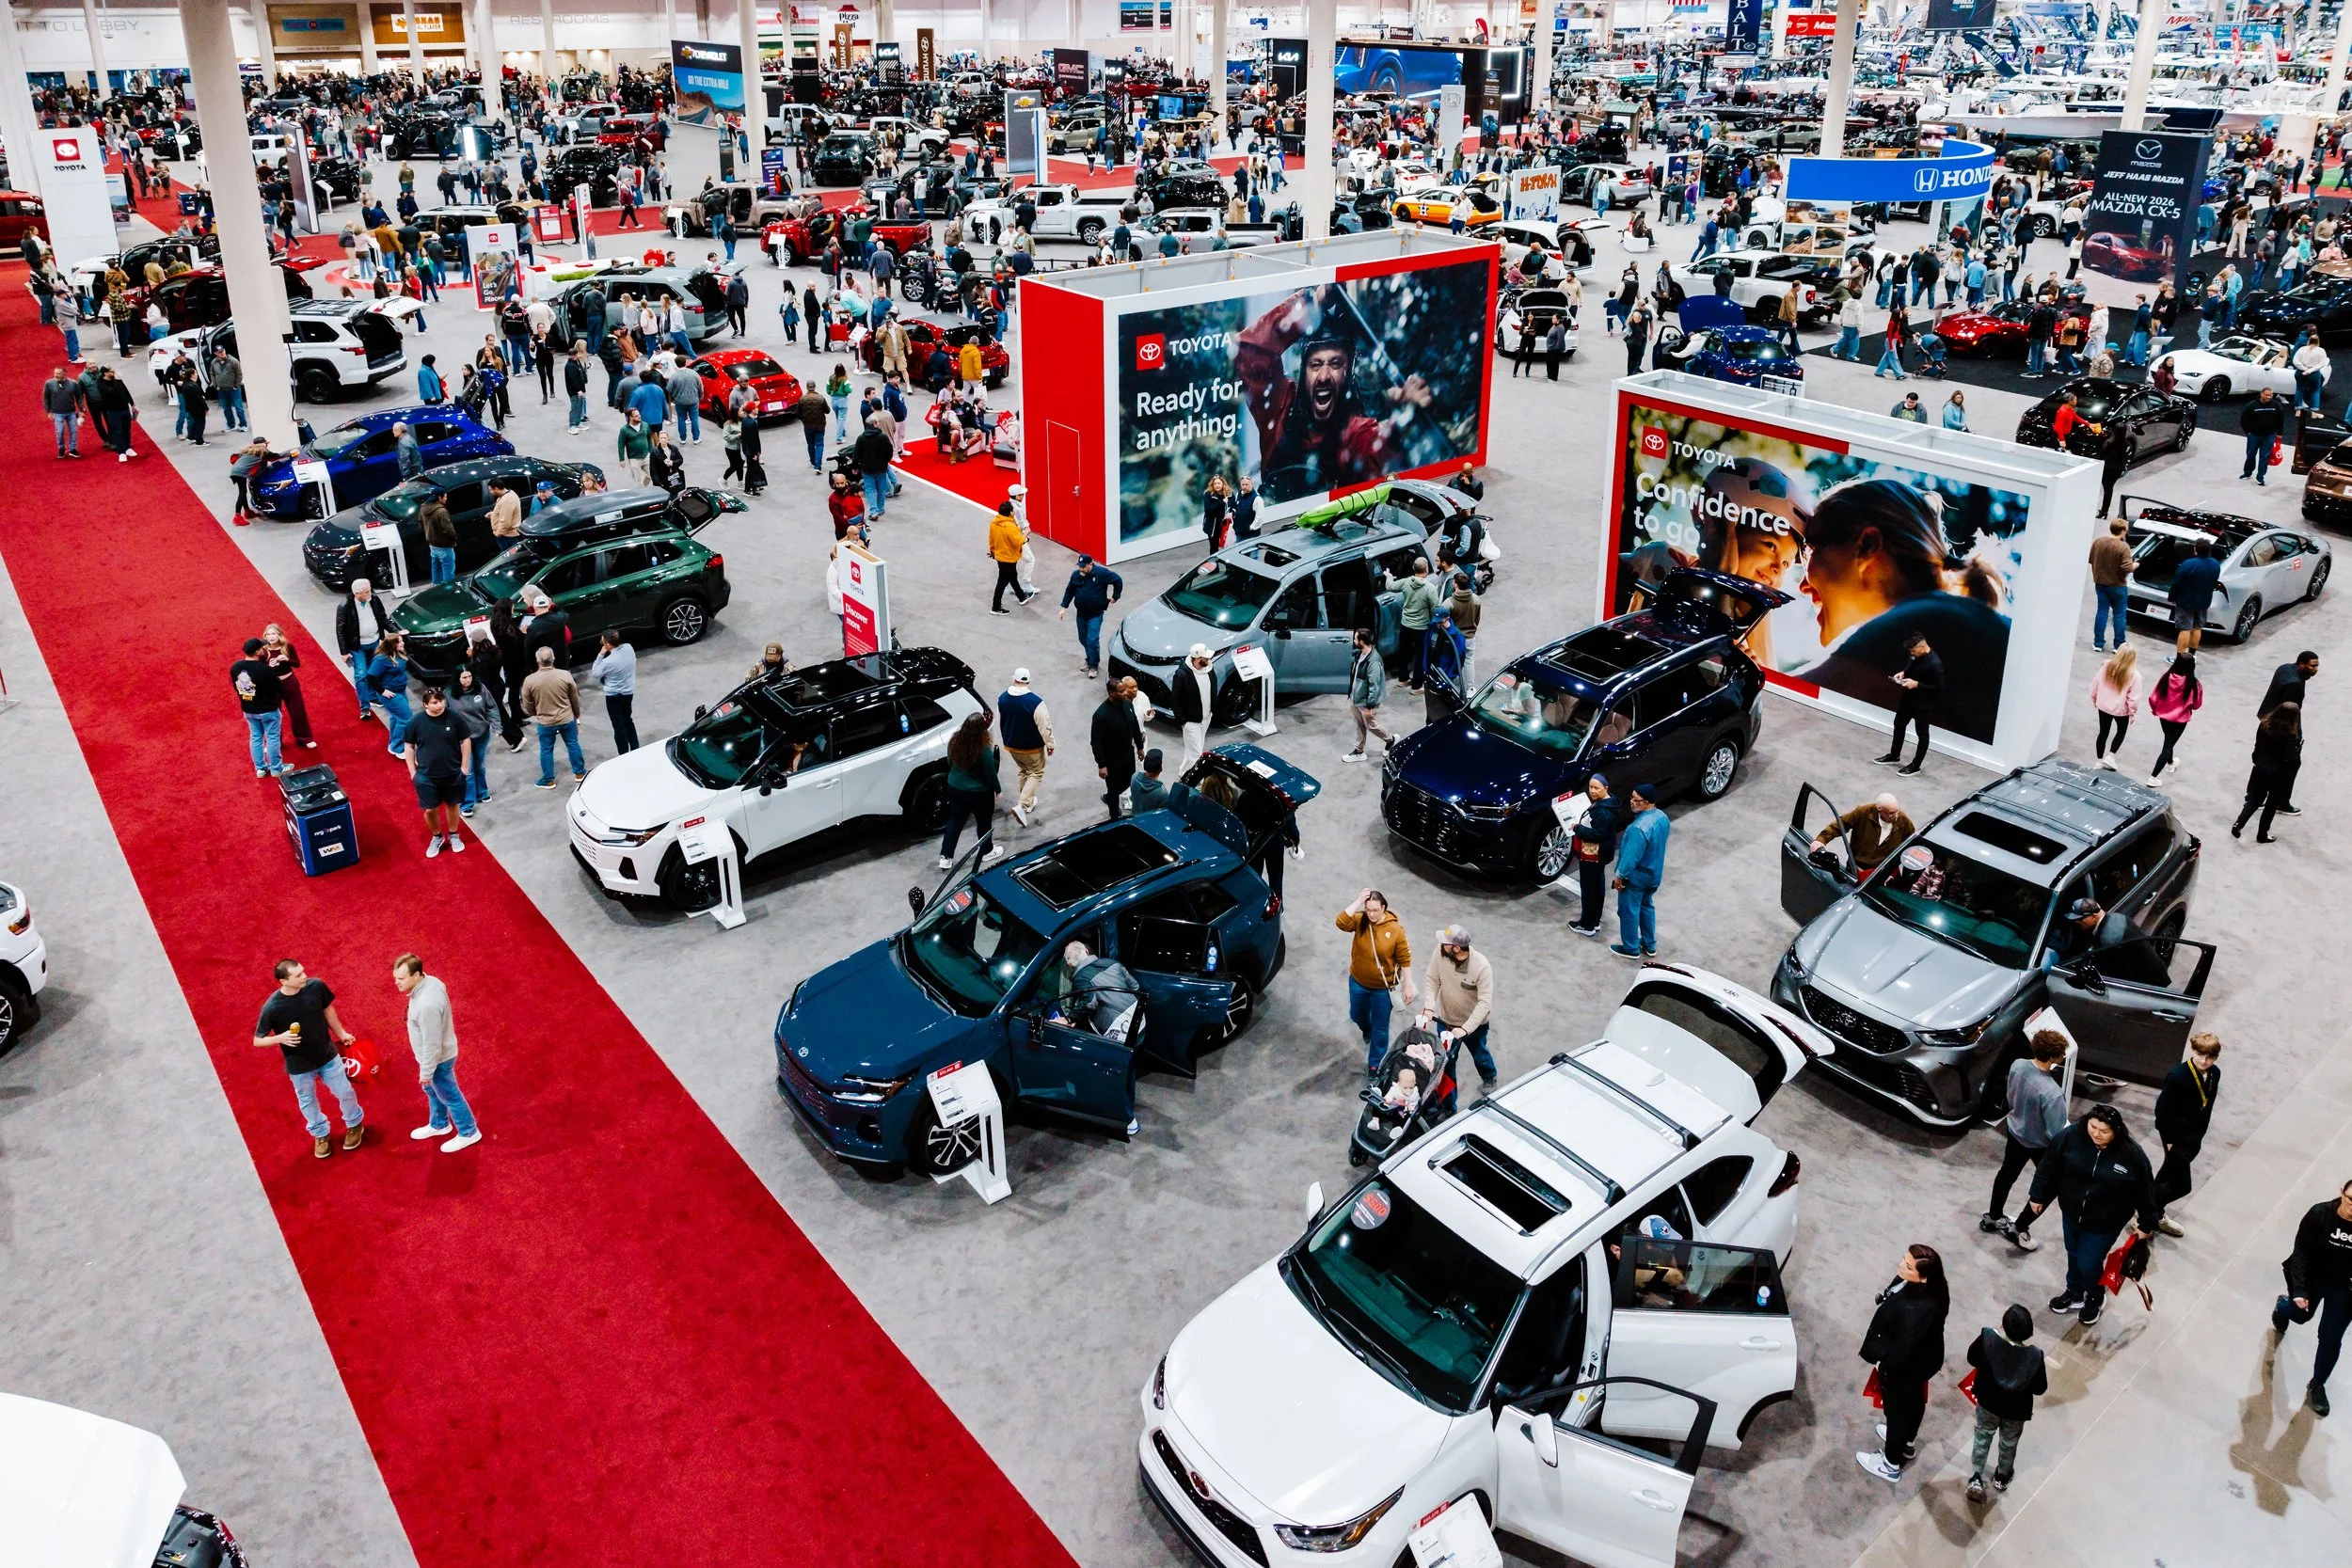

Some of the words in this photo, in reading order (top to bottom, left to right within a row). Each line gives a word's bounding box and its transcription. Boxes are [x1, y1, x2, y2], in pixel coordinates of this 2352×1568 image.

[72, 20, 139, 31] LBBY
[415, 16, 440, 24] EXAS
[510, 14, 610, 24] RESROOMS
[839, 12, 859, 21] Pizza
[1278, 52, 1298, 62] KIA
[1057, 62, 1085, 74] GMC
[1519, 172, 1558, 193] H-TOWN
[1940, 166, 1992, 187] HOND
[2104, 170, 2126, 180] JEFF
[2125, 173, 2152, 182] HAAS
[2152, 175, 2185, 184] MAZDA
[2090, 199, 2145, 215] MAZDA
[2148, 205, 2181, 219] CX-5
[2104, 192, 2148, 204] ALL-NEW
[2149, 196, 2175, 207] 2026
[1168, 332, 1232, 356] TOYOTA
[1136, 382, 1207, 418] Ready
[1212, 377, 1243, 403] for
[1136, 413, 1242, 451] anything.
[1672, 440, 1736, 470] TOYOTA
[1636, 471, 1791, 536] Confidence
[1634, 506, 1661, 533] to
[1666, 519, 1707, 550] go.
[845, 603, 867, 625] Discover
[846, 617, 863, 632] more.
[1363, 1192, 1387, 1216] $500
